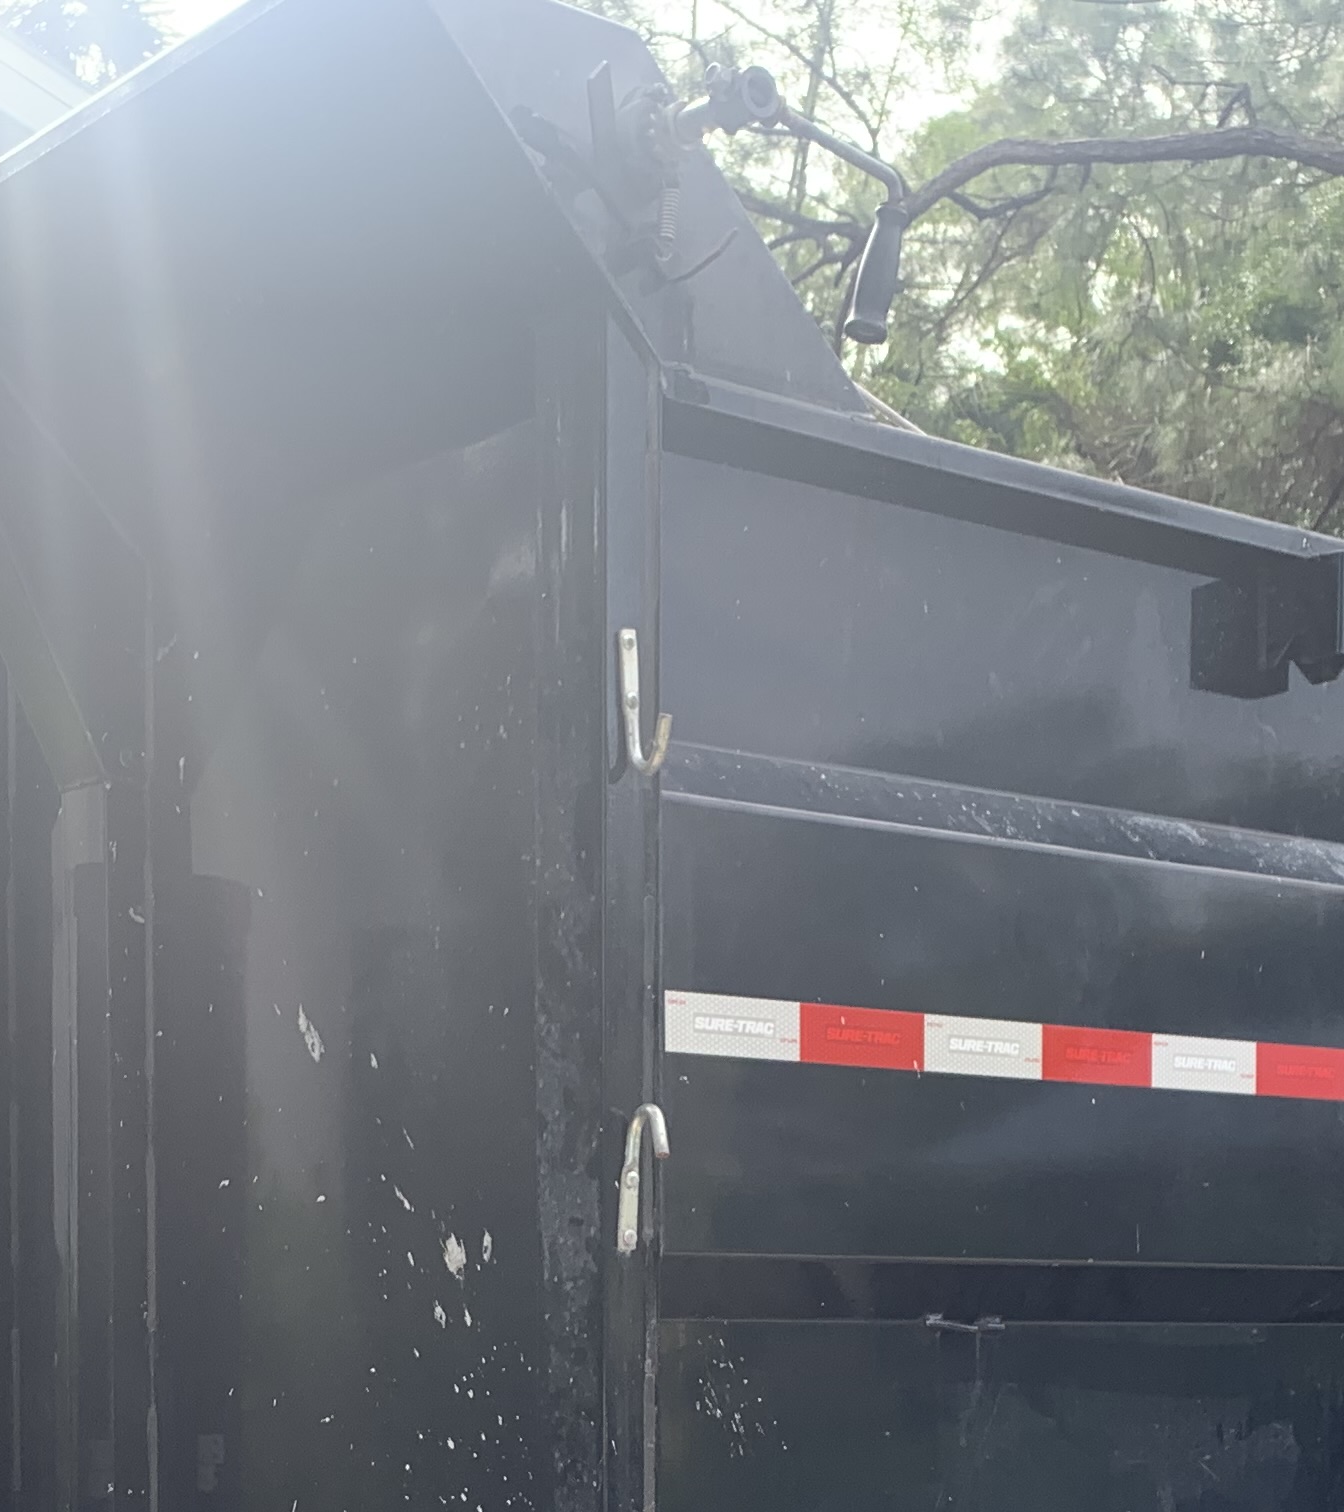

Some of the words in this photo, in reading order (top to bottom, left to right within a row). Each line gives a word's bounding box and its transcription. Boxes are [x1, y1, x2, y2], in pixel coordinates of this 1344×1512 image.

[694, 1016, 775, 1036] SURE-TRAC
[826, 1027, 901, 1045] SURE-TRAC
[949, 1037, 1020, 1055] SURE-TRAC
[1174, 1055, 1236, 1072] SURE-TRAC
